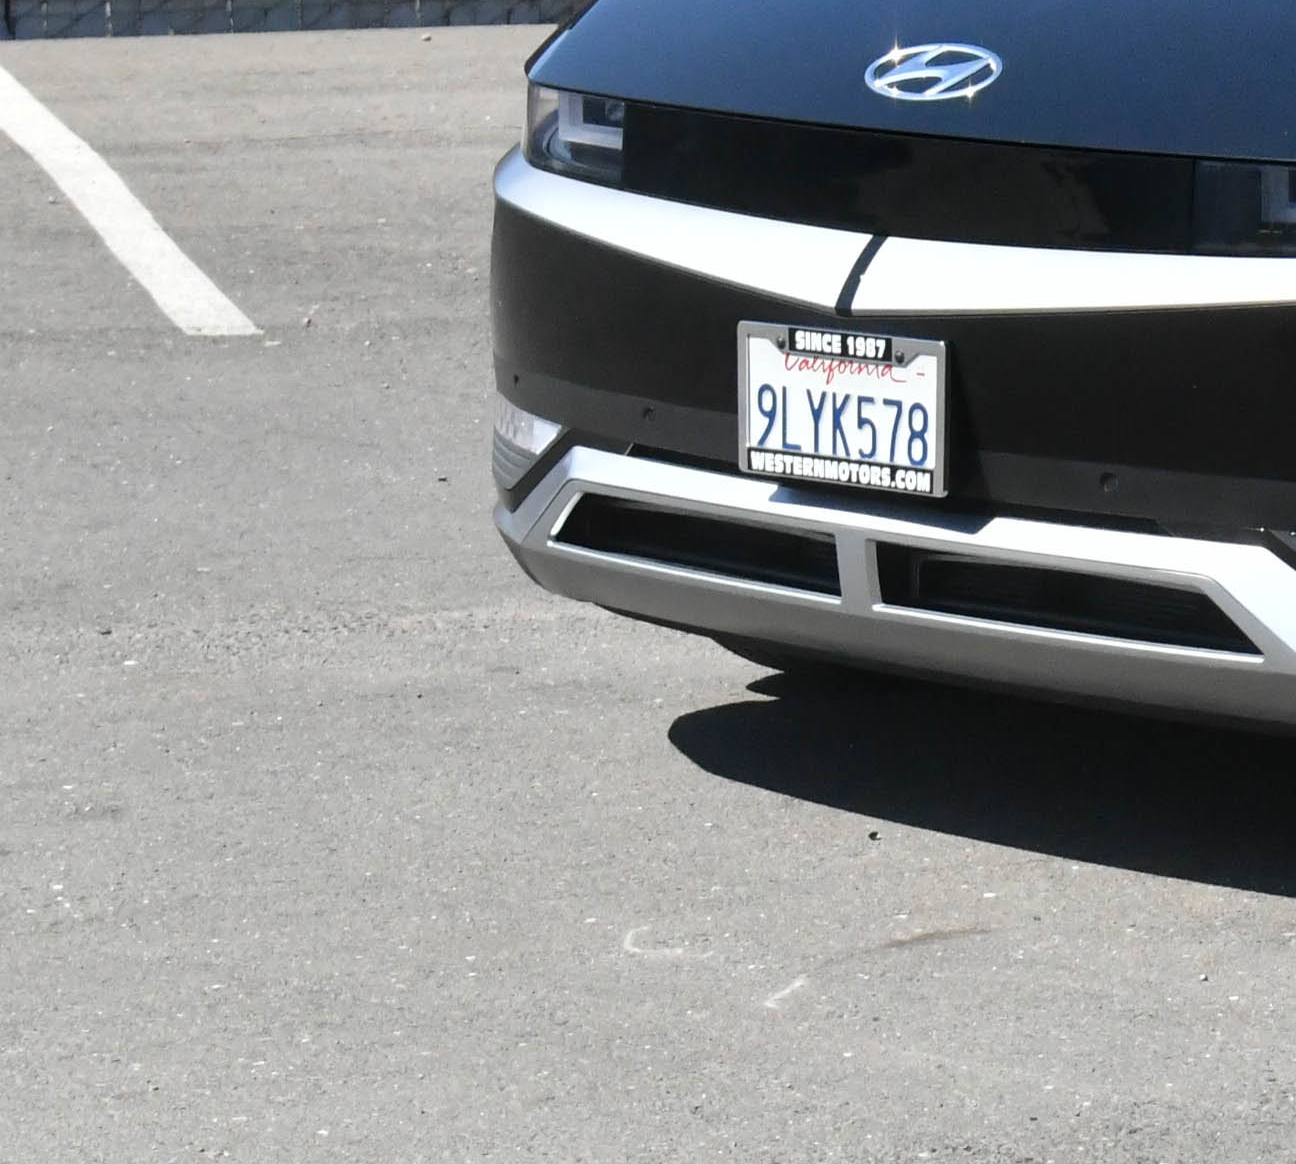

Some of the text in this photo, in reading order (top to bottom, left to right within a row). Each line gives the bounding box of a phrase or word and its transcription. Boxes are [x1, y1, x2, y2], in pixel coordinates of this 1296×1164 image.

[795, 330, 887, 359] SINCE 1987
[784, 352, 907, 385] California
[757, 383, 929, 467] 9LYK578
[750, 450, 931, 493] WESTERNMOTORS.COM
